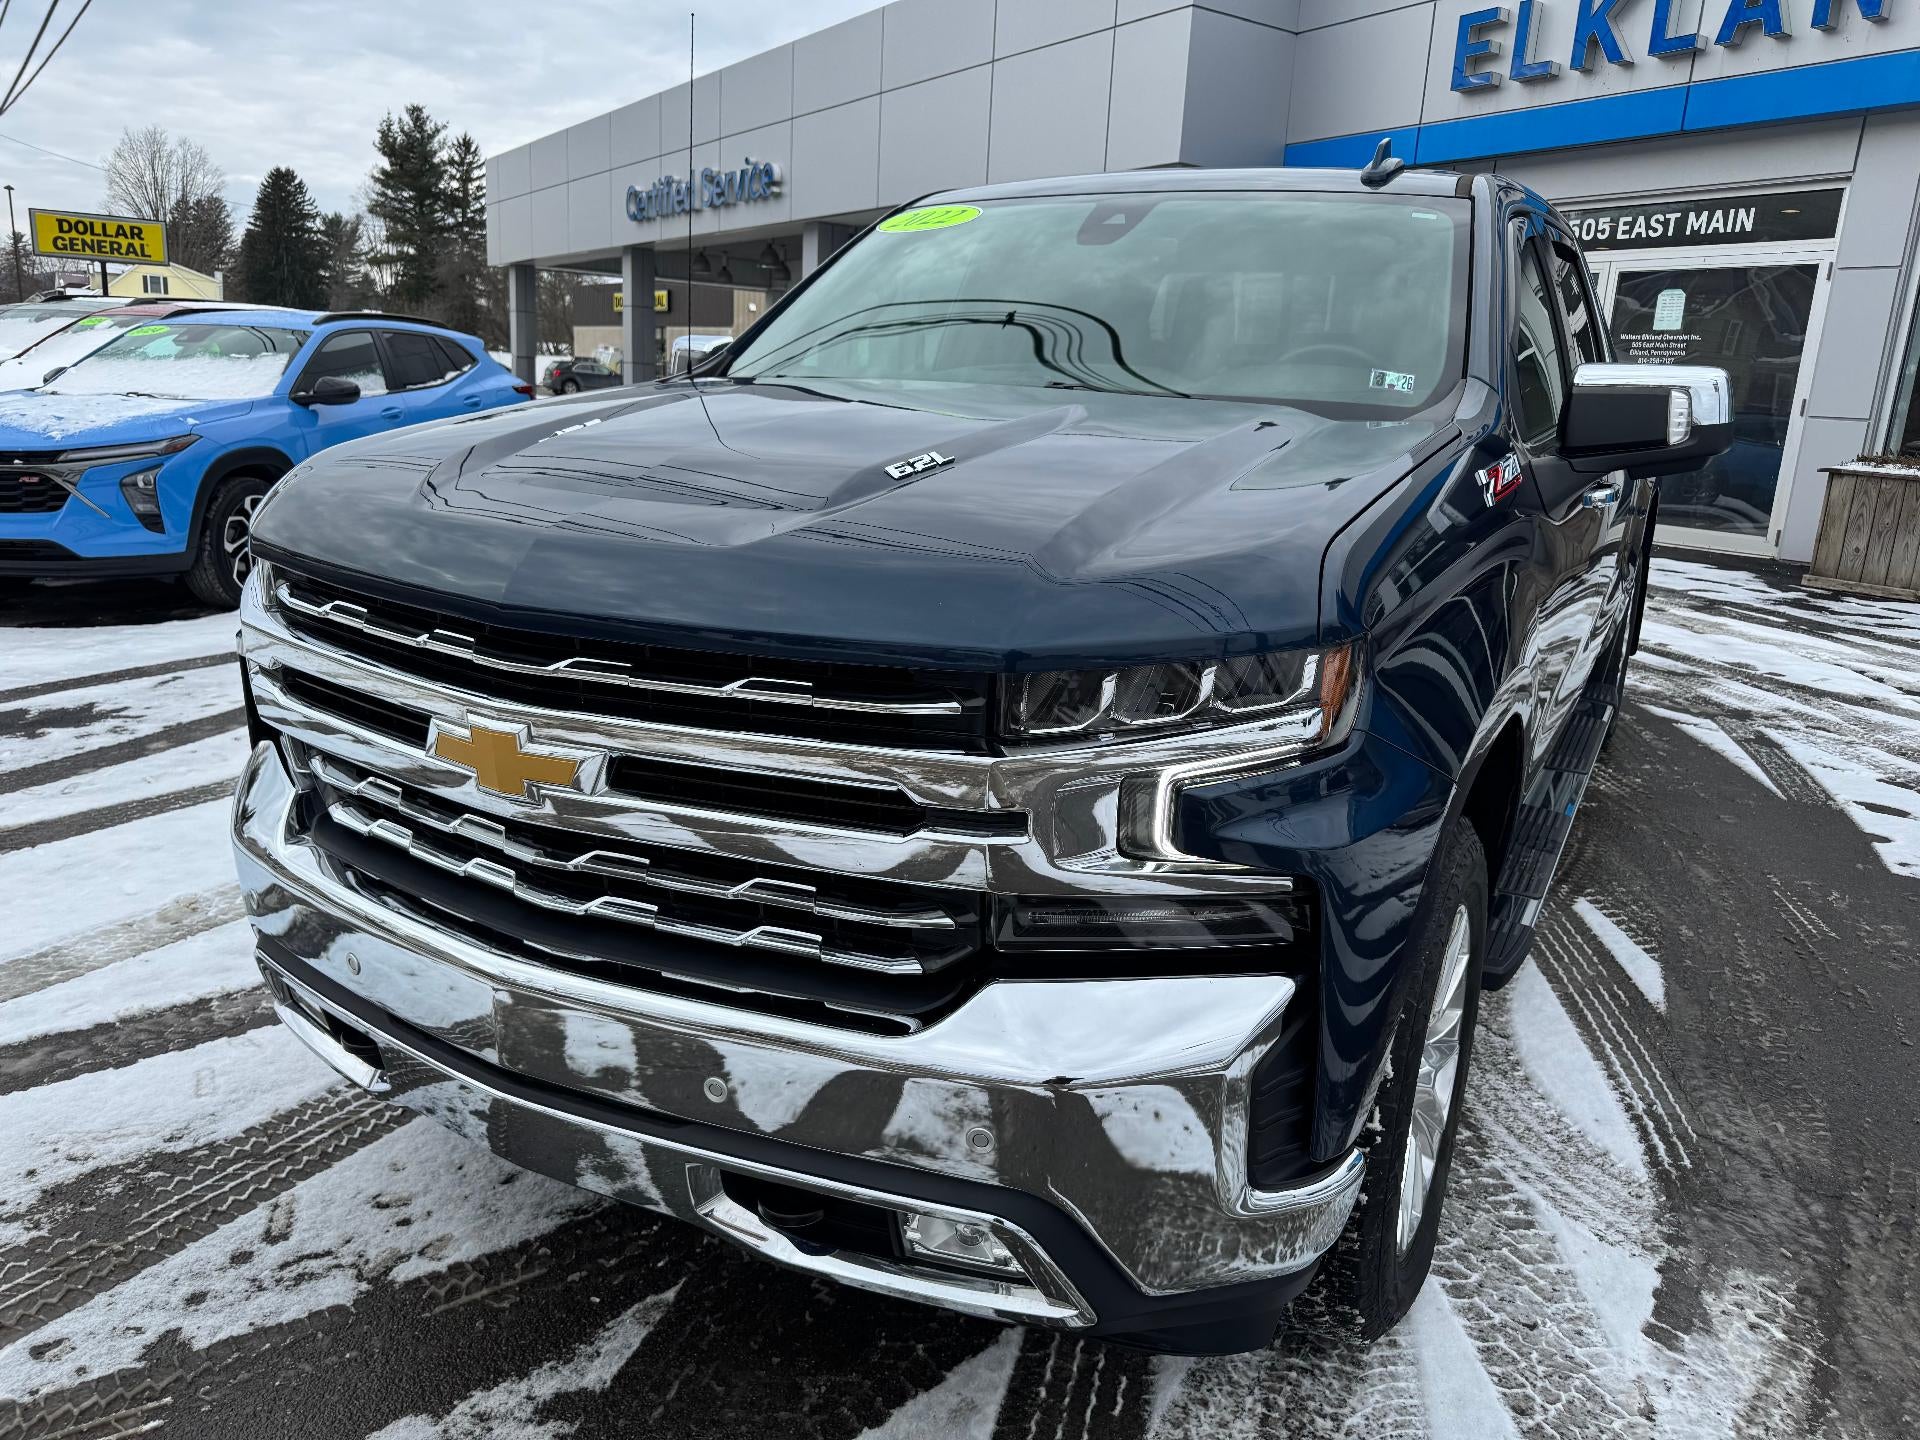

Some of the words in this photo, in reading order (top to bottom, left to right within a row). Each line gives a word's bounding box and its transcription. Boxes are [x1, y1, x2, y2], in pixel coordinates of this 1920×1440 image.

[626, 166, 697, 222] Certified
[701, 156, 781, 208] Service
[56, 218, 145, 240] DOLLAR
[1569, 217, 1611, 241] 505
[1616, 212, 1681, 240] EAST
[1685, 207, 1756, 236] MAIN
[52, 236, 151, 258] GENERAL
[1642, 333, 1662, 341] Elkland
[1662, 333, 1690, 341] Chevrolet
[1669, 341, 1687, 349] Street
[1650, 349, 1686, 357] Pennsylvania
[1401, 375, 1413, 390] 26
